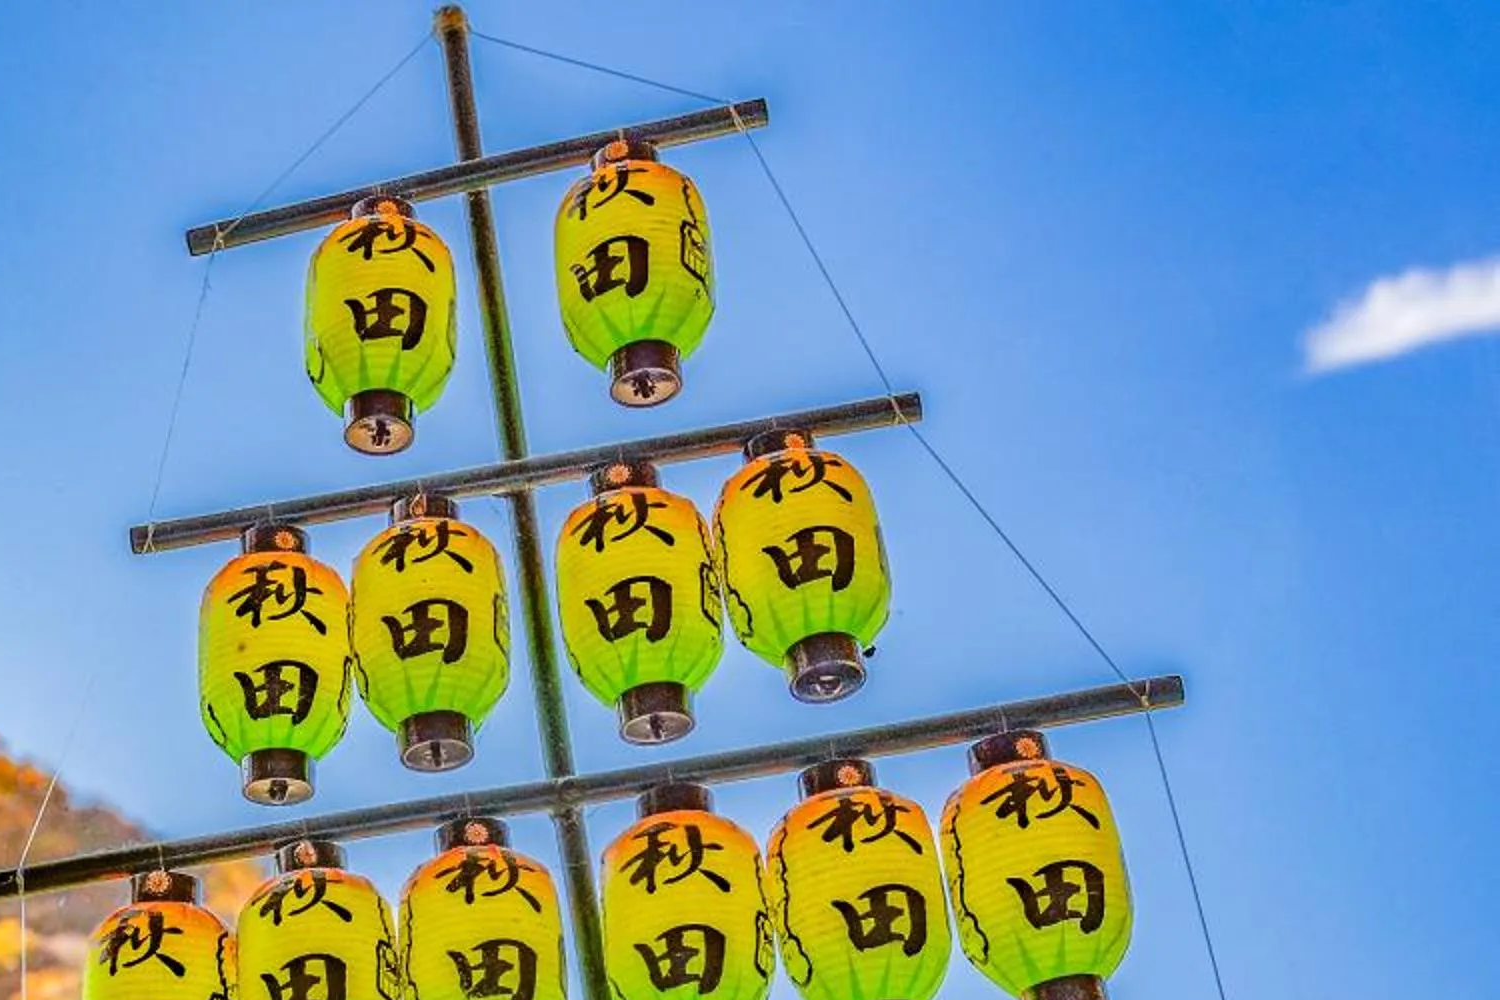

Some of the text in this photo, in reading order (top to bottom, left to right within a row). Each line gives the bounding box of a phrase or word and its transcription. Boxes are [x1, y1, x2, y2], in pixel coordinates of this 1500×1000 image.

[339, 219, 435, 350] 秋田
[568, 166, 654, 301] 秋田
[373, 523, 473, 664] 秋田
[571, 493, 675, 644] 秋田
[743, 453, 859, 592] 秋田
[227, 563, 327, 726] 秋田
[620, 823, 732, 995] 秋田
[807, 797, 927, 957] 秋田
[981, 769, 1105, 934] 秋田
